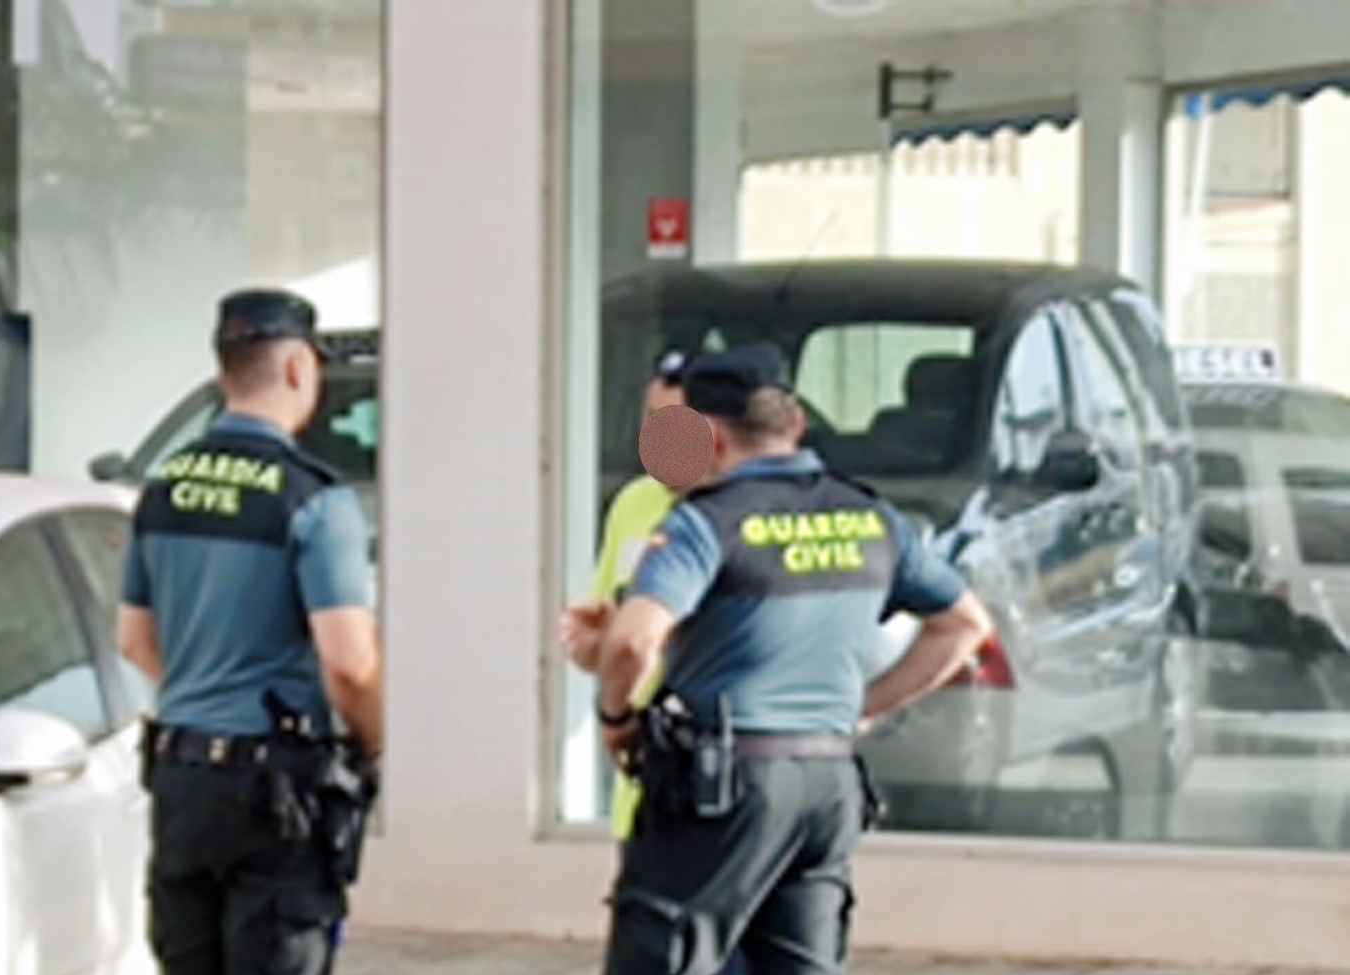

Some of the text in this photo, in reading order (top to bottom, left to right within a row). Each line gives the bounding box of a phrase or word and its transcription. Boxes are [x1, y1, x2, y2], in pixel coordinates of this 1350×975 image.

[148, 453, 283, 494] UARDIA
[740, 511, 886, 546] GUARDIA
[782, 542, 865, 574] CIVIL
